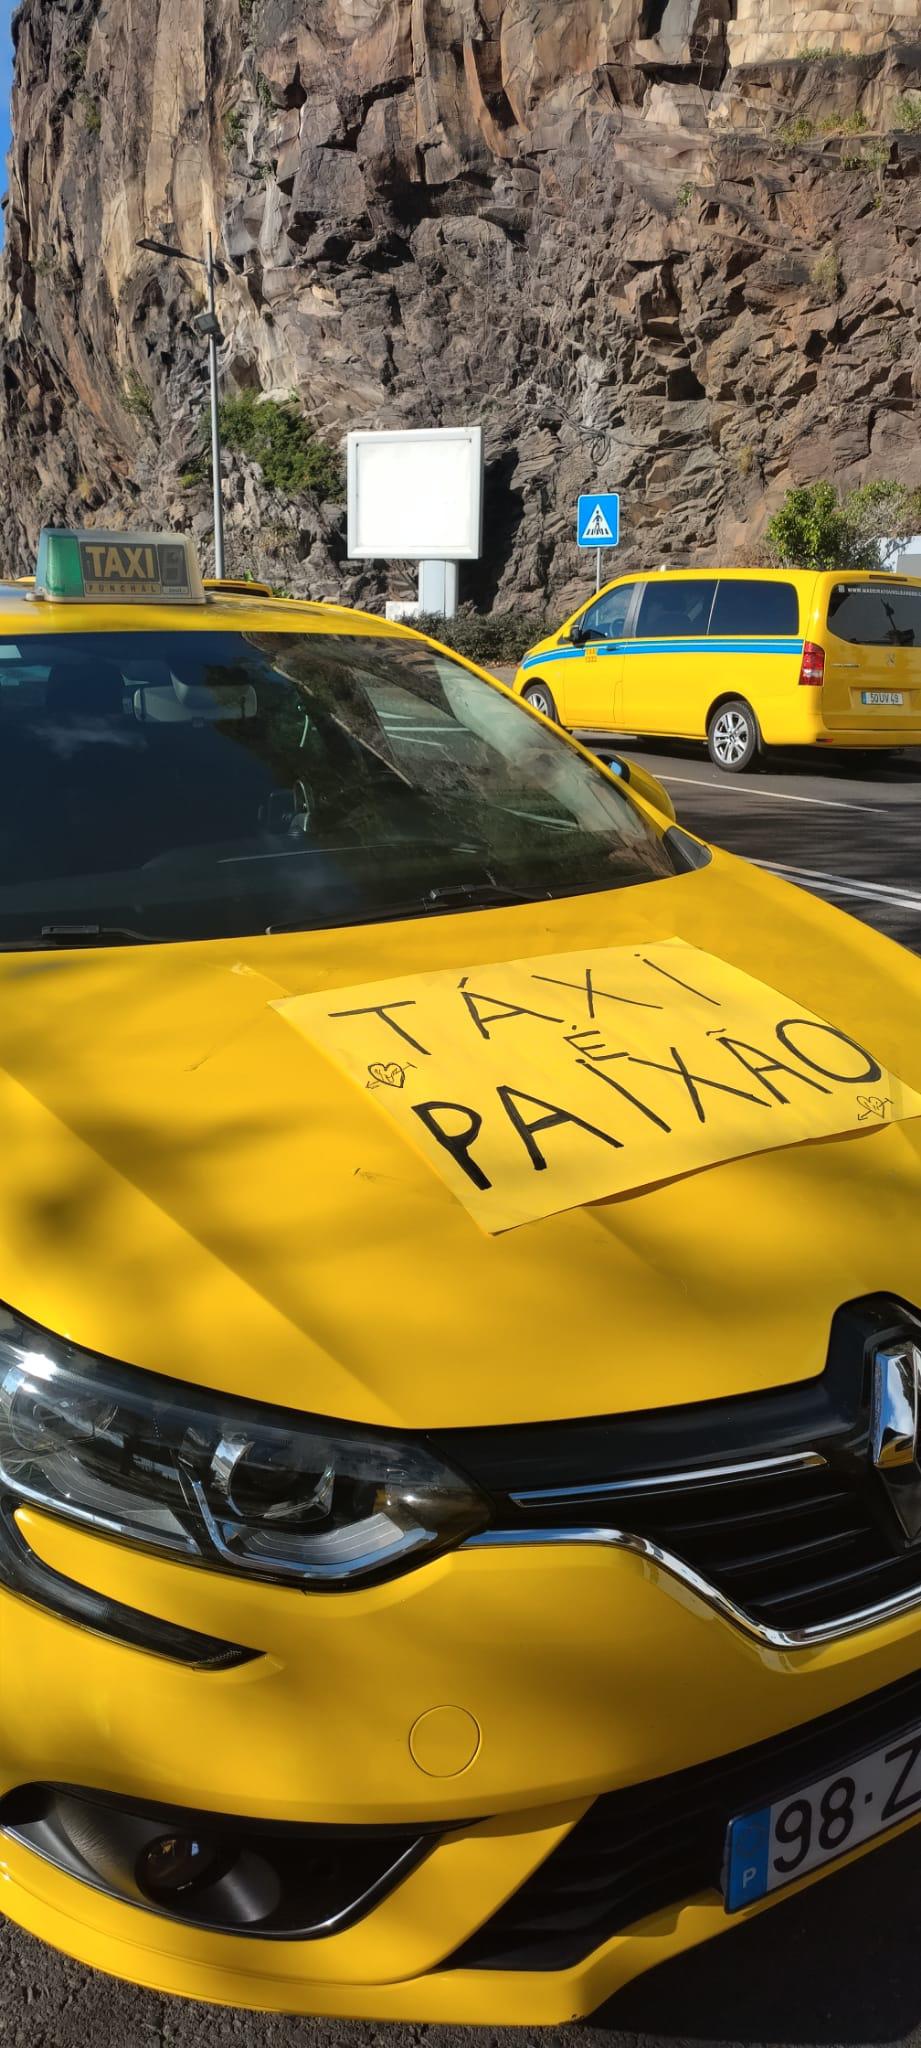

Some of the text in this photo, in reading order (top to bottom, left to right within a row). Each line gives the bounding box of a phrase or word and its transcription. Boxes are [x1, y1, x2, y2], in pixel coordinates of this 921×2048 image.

[84, 546, 155, 578] TAXI
[88, 583, 157, 593] FUNCHAL
[562, 1024, 630, 1061] É
[411, 1018, 882, 1191] PAIXÃO
[742, 1866, 757, 1889] P
